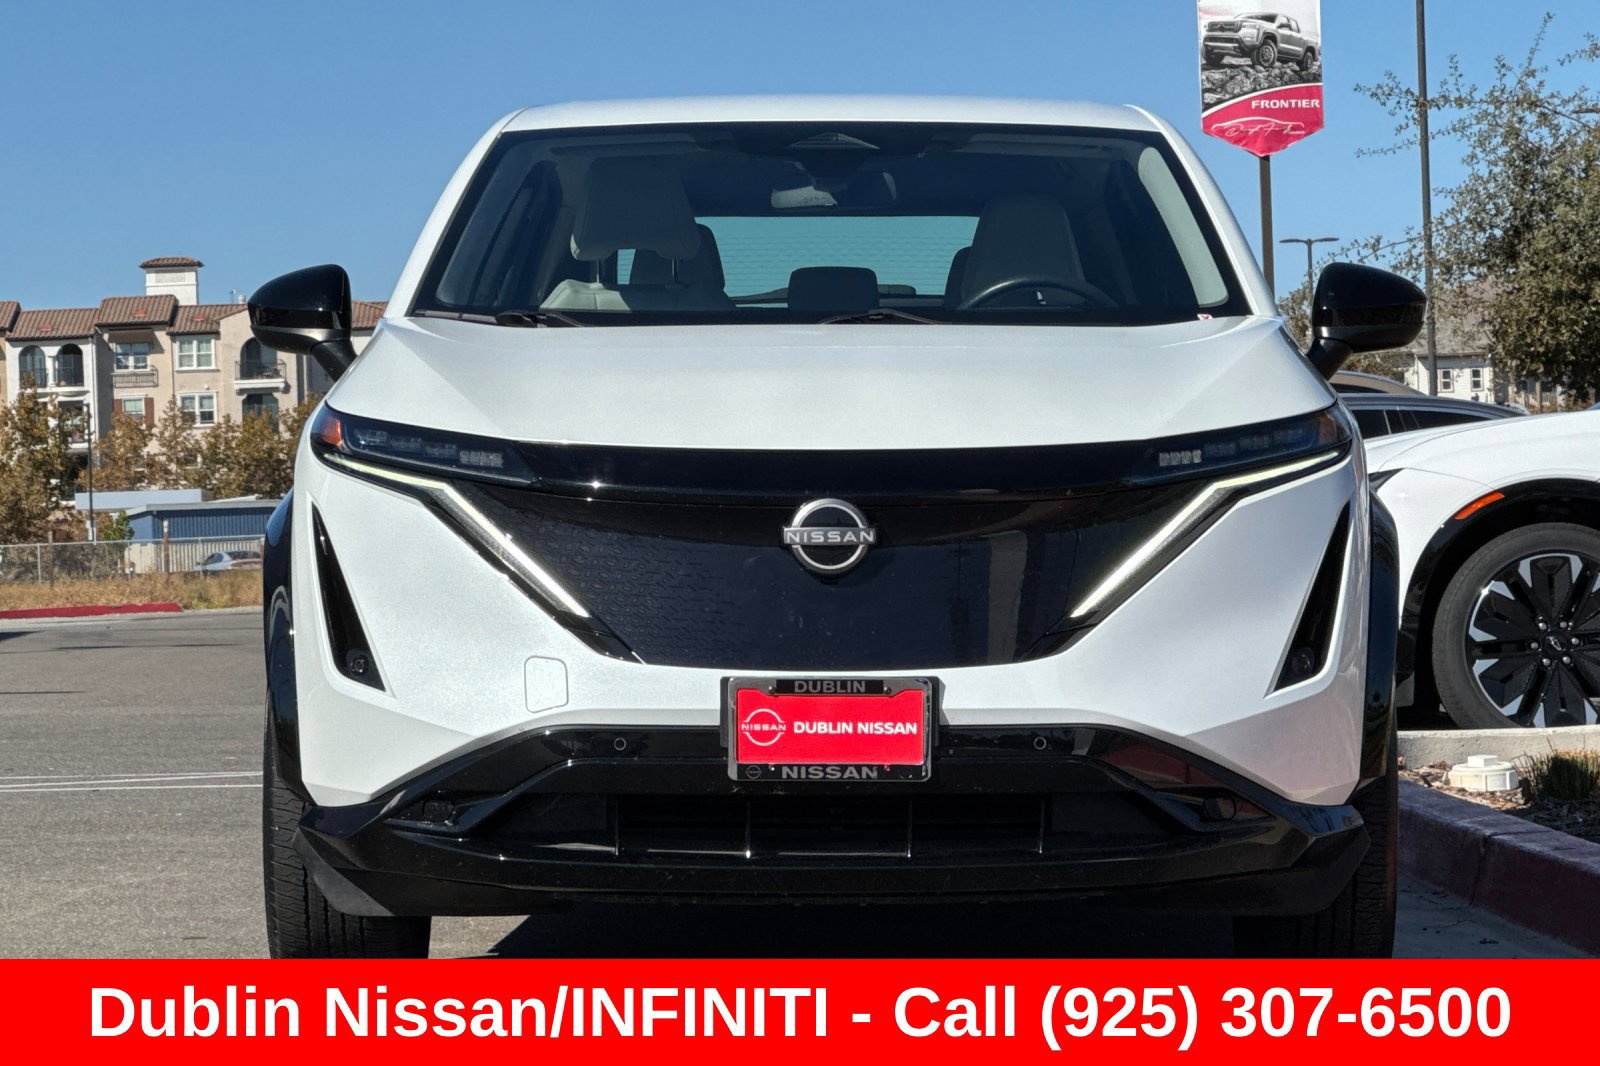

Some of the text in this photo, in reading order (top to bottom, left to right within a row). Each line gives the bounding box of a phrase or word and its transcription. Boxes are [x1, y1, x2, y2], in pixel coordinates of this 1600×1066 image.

[1251, 99, 1320, 109] FRONTIER
[786, 531, 874, 543] NISSAN
[794, 680, 866, 694] DUBLIN
[741, 723, 786, 731] NISSAN
[793, 721, 917, 735] DUBLIN NISSAN
[782, 765, 878, 780] NISSAN
